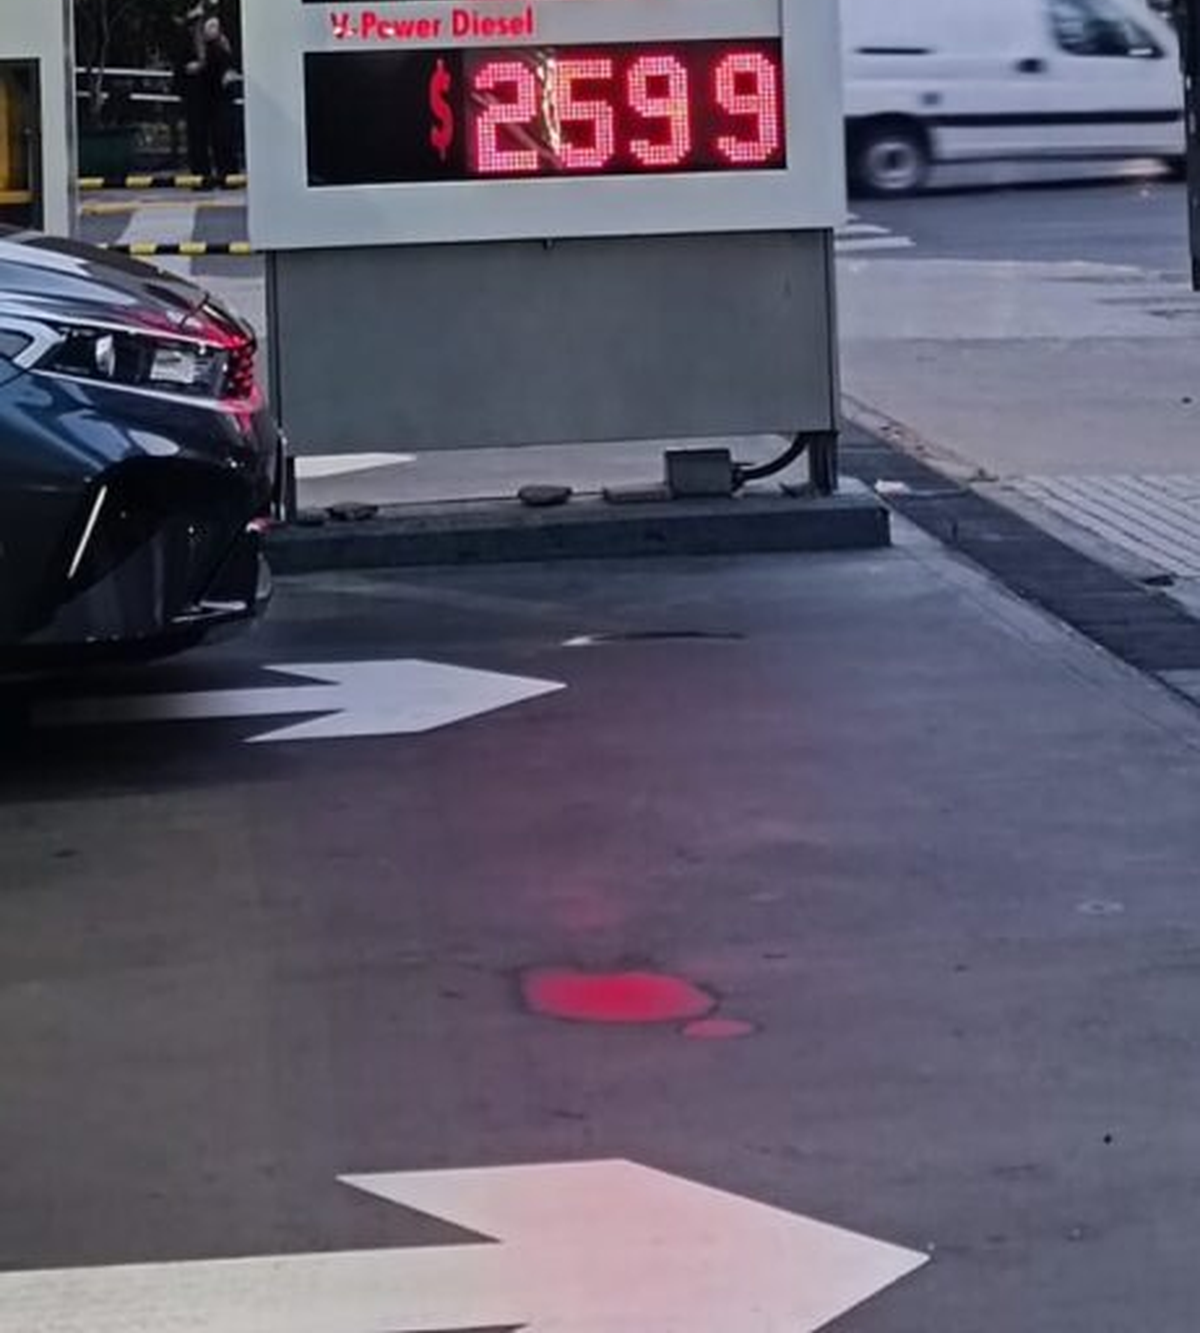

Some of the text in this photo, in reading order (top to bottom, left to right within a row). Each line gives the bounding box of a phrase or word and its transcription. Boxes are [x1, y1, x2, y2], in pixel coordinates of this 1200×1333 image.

[331, 5, 533, 40] V-Power Diesel
[474, 53, 777, 173] 2599
